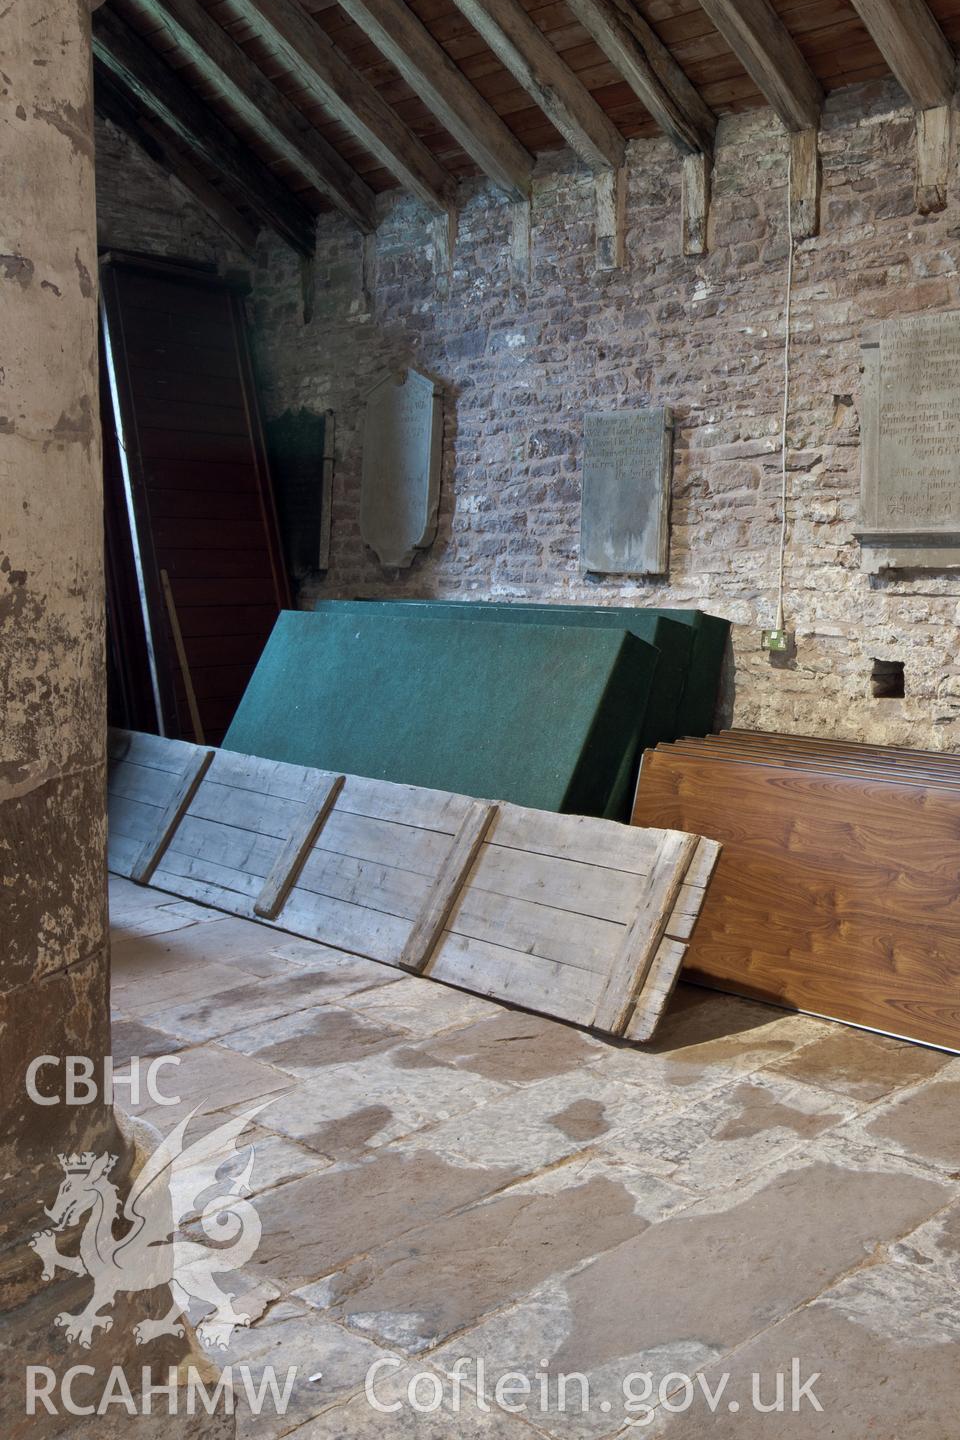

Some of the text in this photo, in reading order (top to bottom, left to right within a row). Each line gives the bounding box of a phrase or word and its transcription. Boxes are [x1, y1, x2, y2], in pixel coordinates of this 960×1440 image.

[910, 383, 931, 396] Aged
[937, 421, 955, 433] Life
[897, 435, 909, 447] of
[911, 446, 935, 461] Aged
